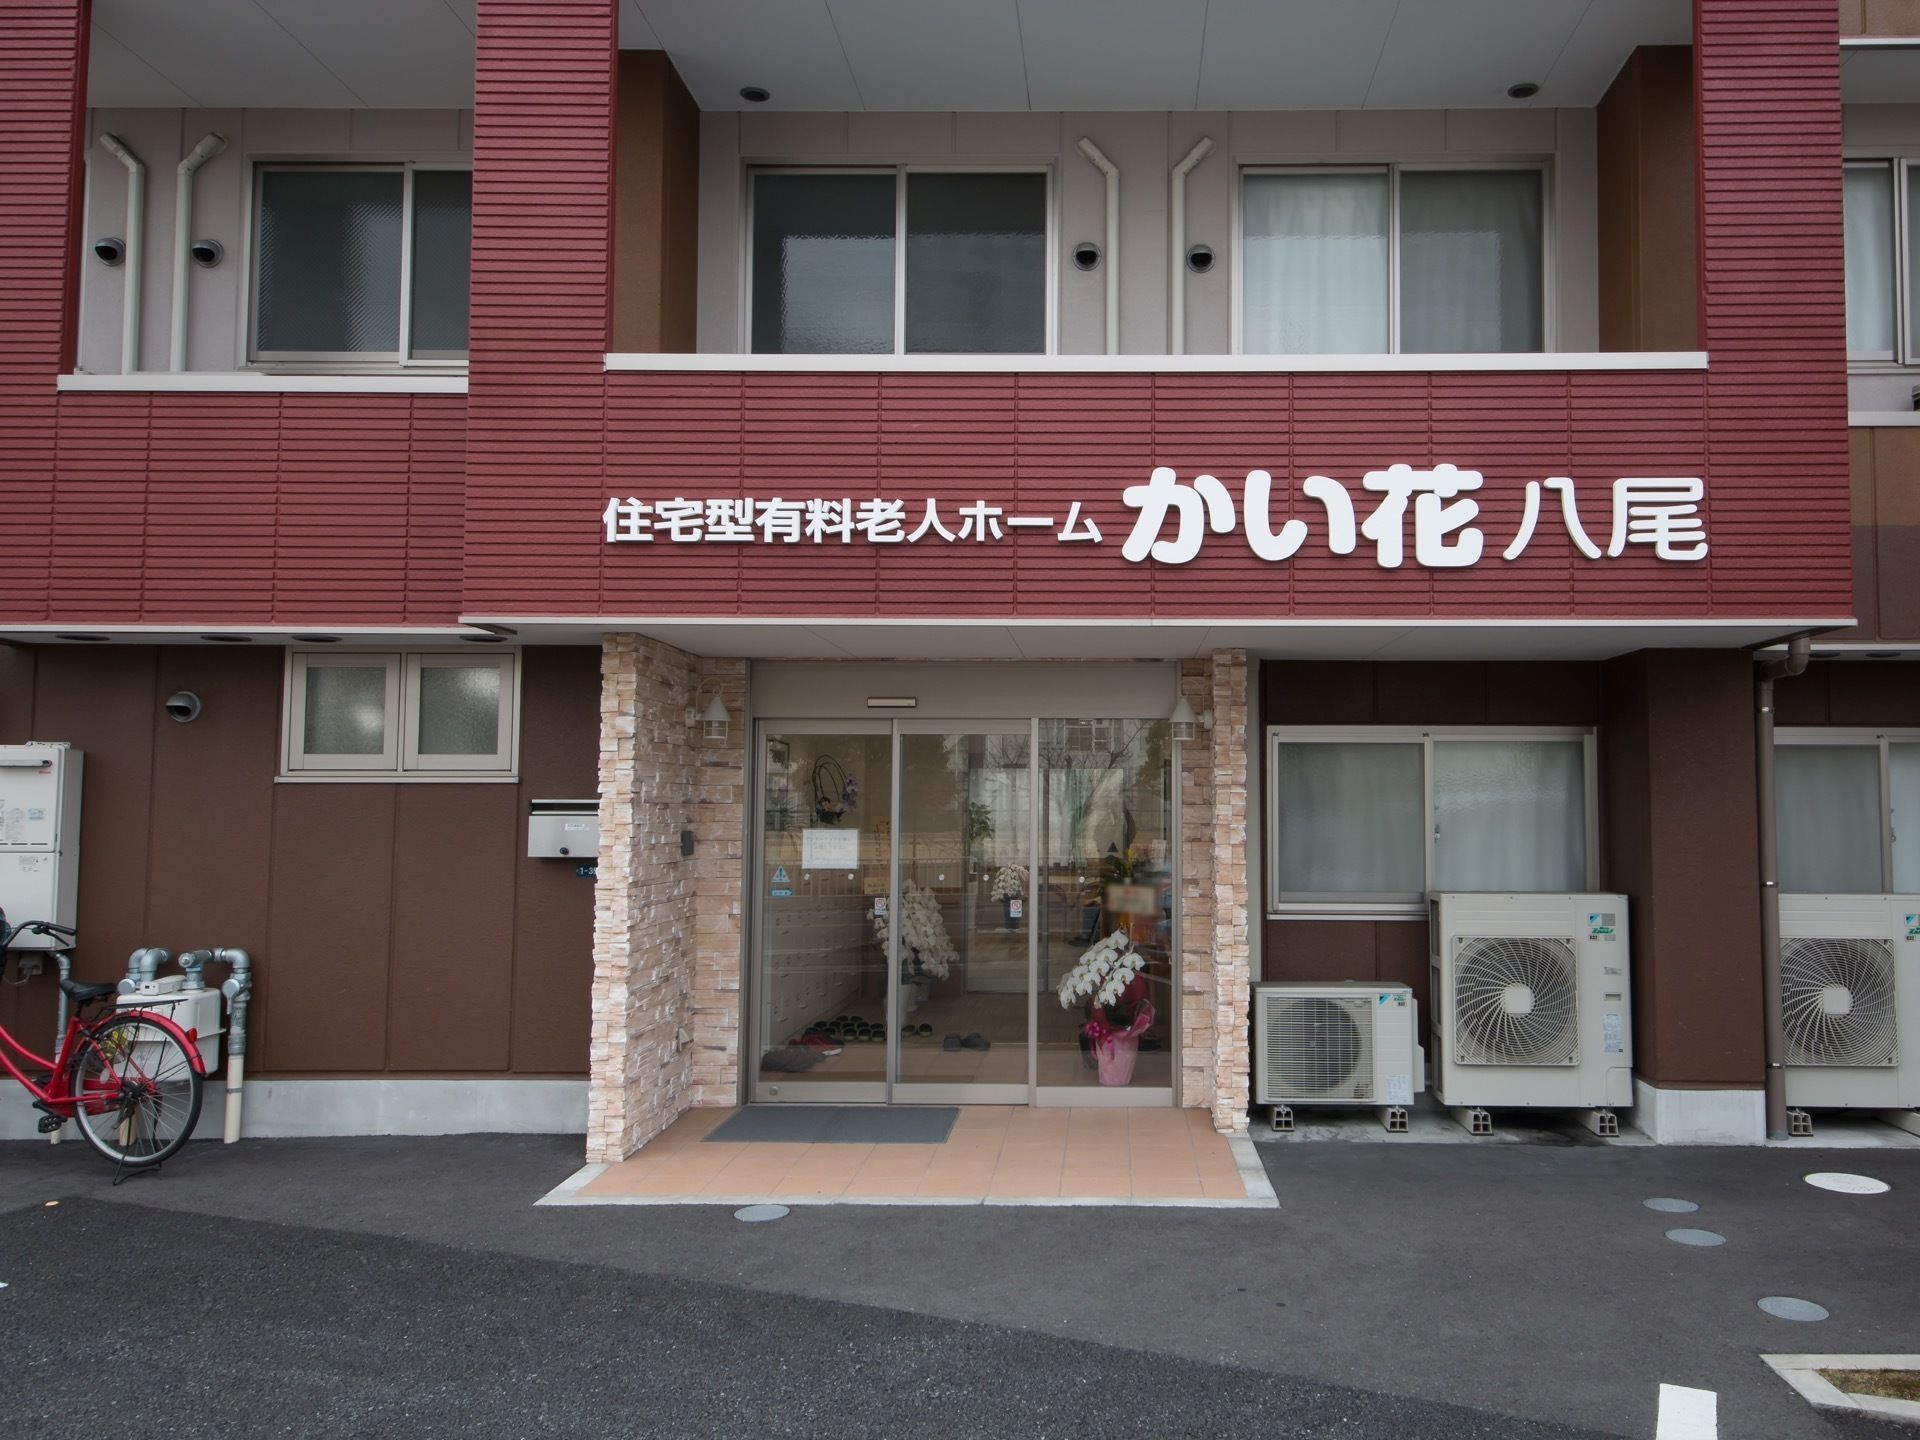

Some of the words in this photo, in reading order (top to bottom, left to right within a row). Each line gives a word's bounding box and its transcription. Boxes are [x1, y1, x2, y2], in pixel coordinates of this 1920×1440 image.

[602, 496, 1104, 545] 住宅型有料老人ホーム
[1121, 463, 1485, 569] かい花
[1502, 477, 1709, 563] 八尾
